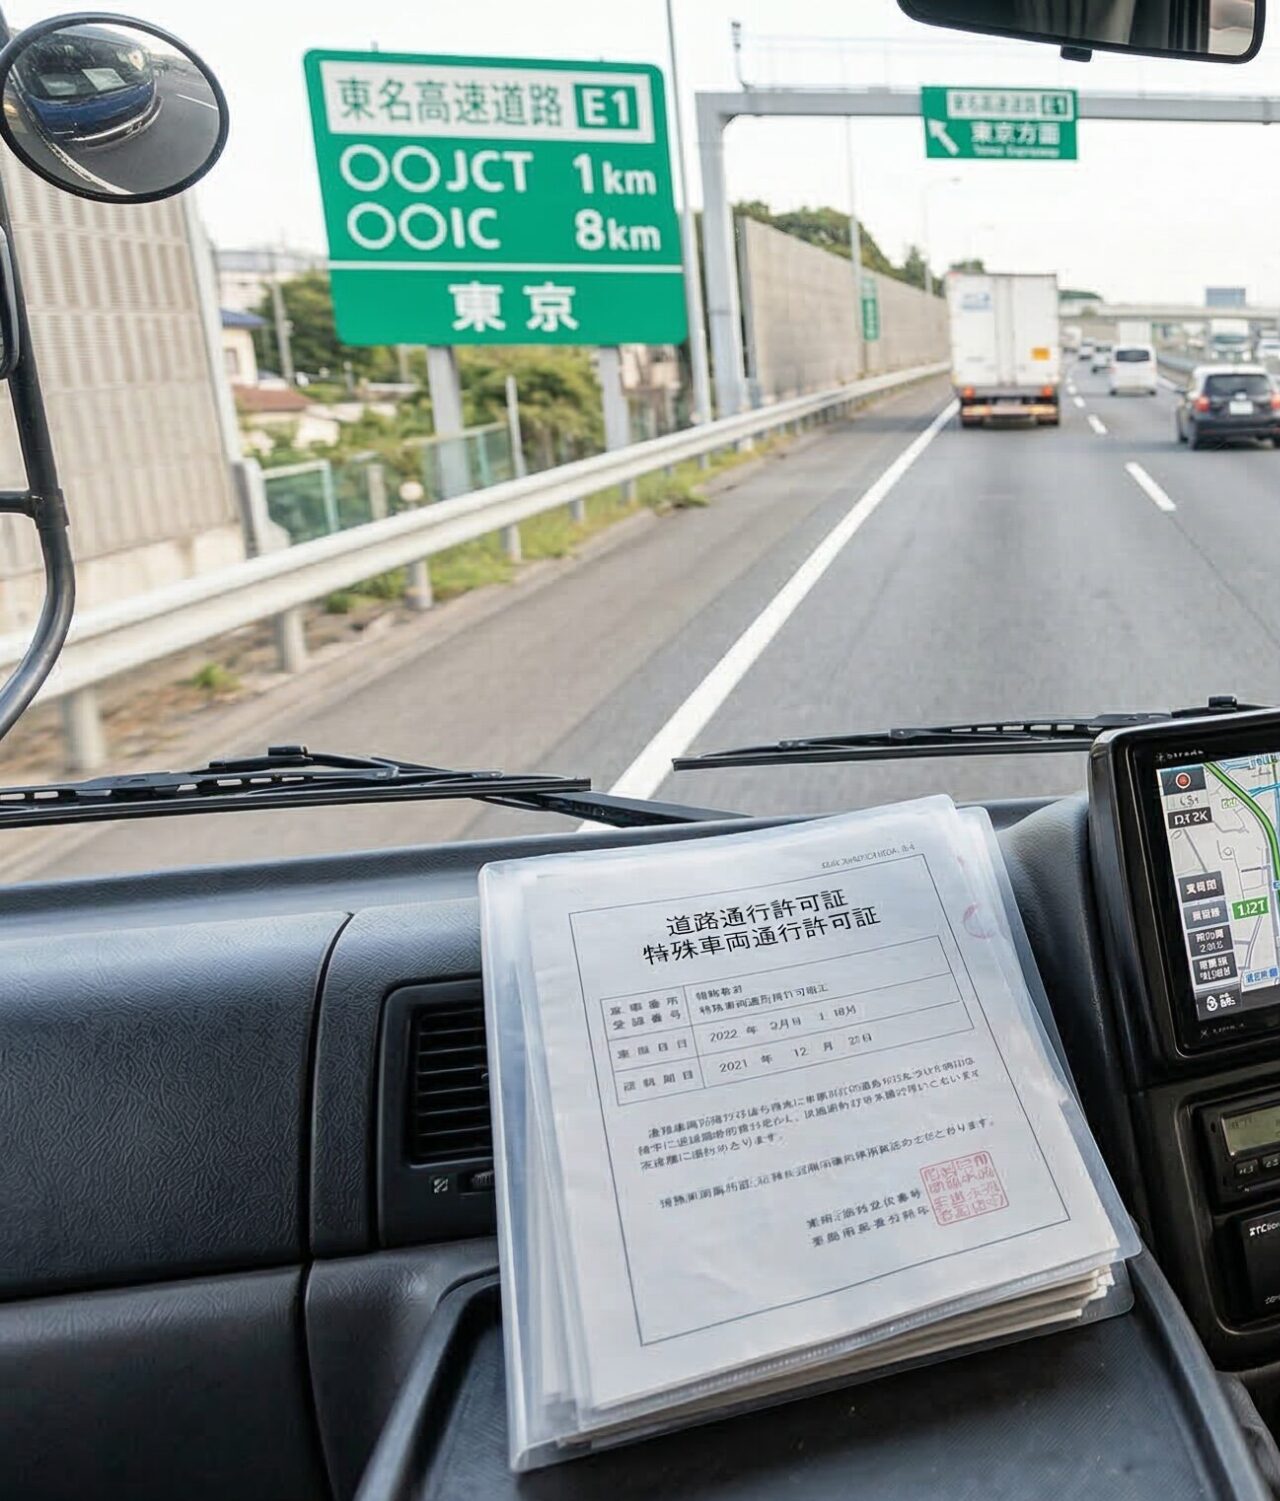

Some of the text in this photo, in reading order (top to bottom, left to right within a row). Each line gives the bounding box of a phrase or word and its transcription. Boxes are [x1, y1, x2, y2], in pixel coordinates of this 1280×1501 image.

[336, 76, 629, 128] 東名高速道路 E1
[642, 905, 882, 966] 特殊車両通行許可証
[665, 888, 849, 937] 道路通行許可証
